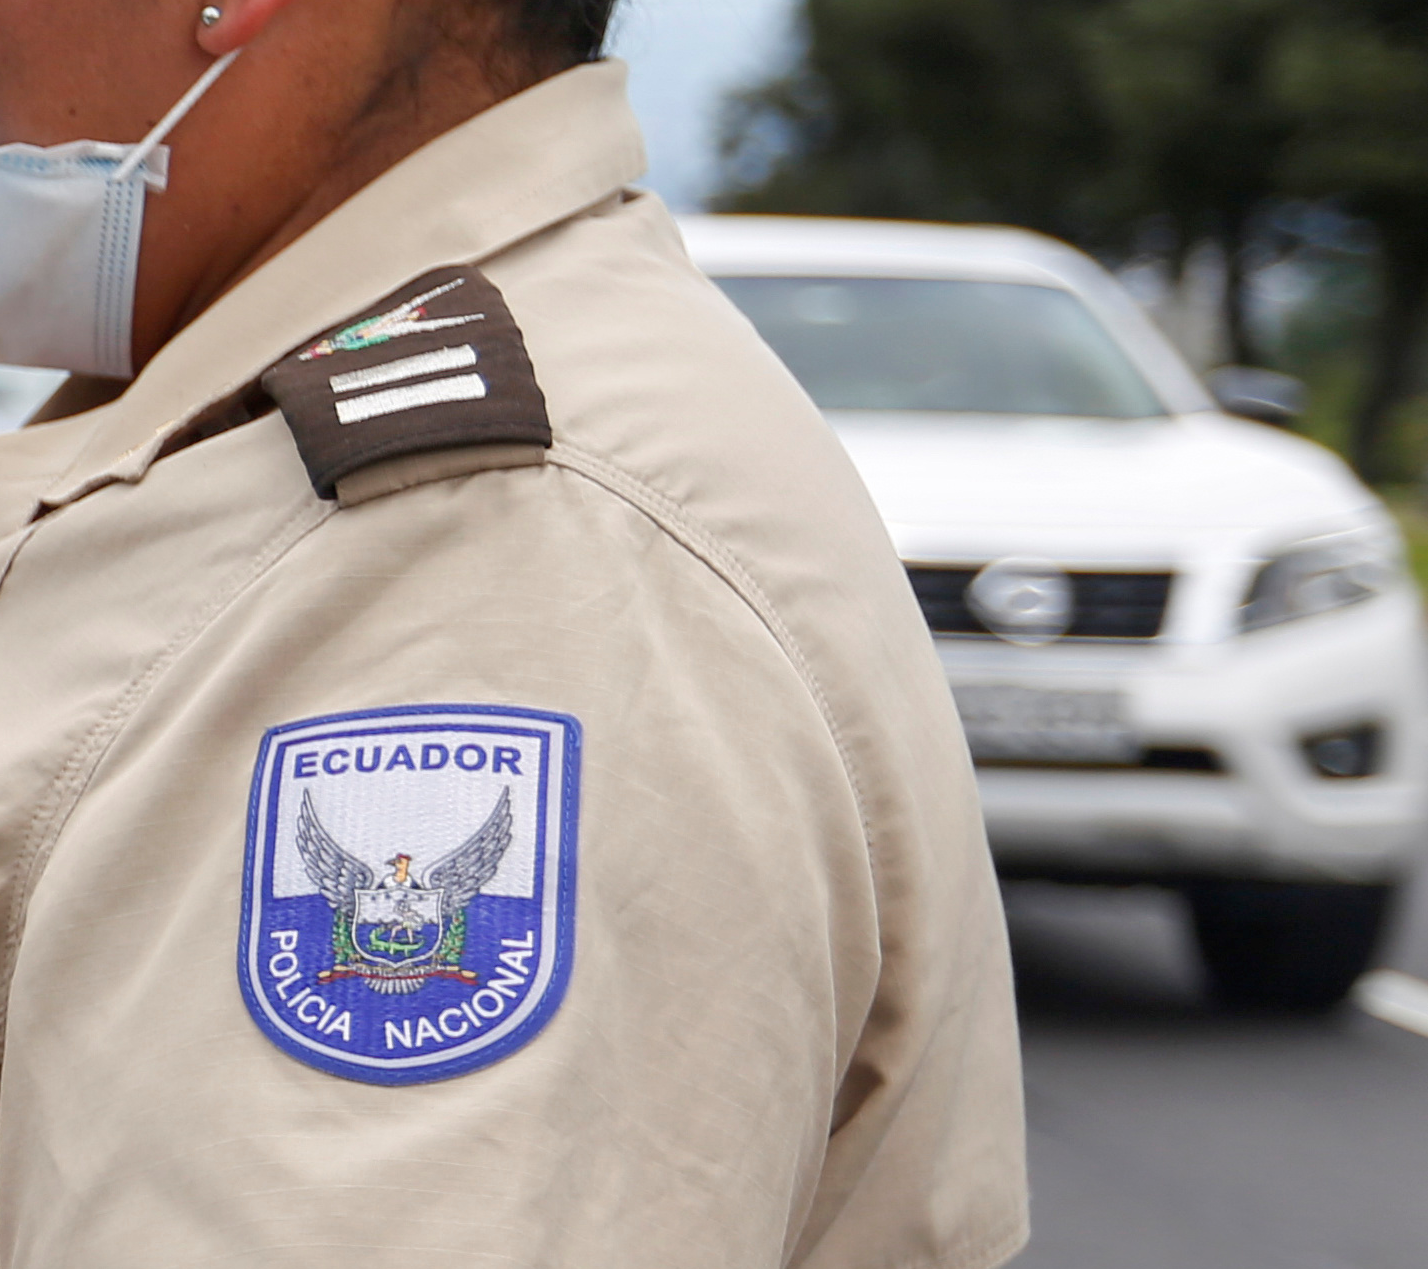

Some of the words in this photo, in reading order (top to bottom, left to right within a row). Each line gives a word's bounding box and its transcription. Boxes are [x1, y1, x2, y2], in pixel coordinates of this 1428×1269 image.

[293, 741, 525, 780] ECUADOR
[267, 928, 353, 1043] POLICIA
[384, 929, 535, 1051] NACIONAL
